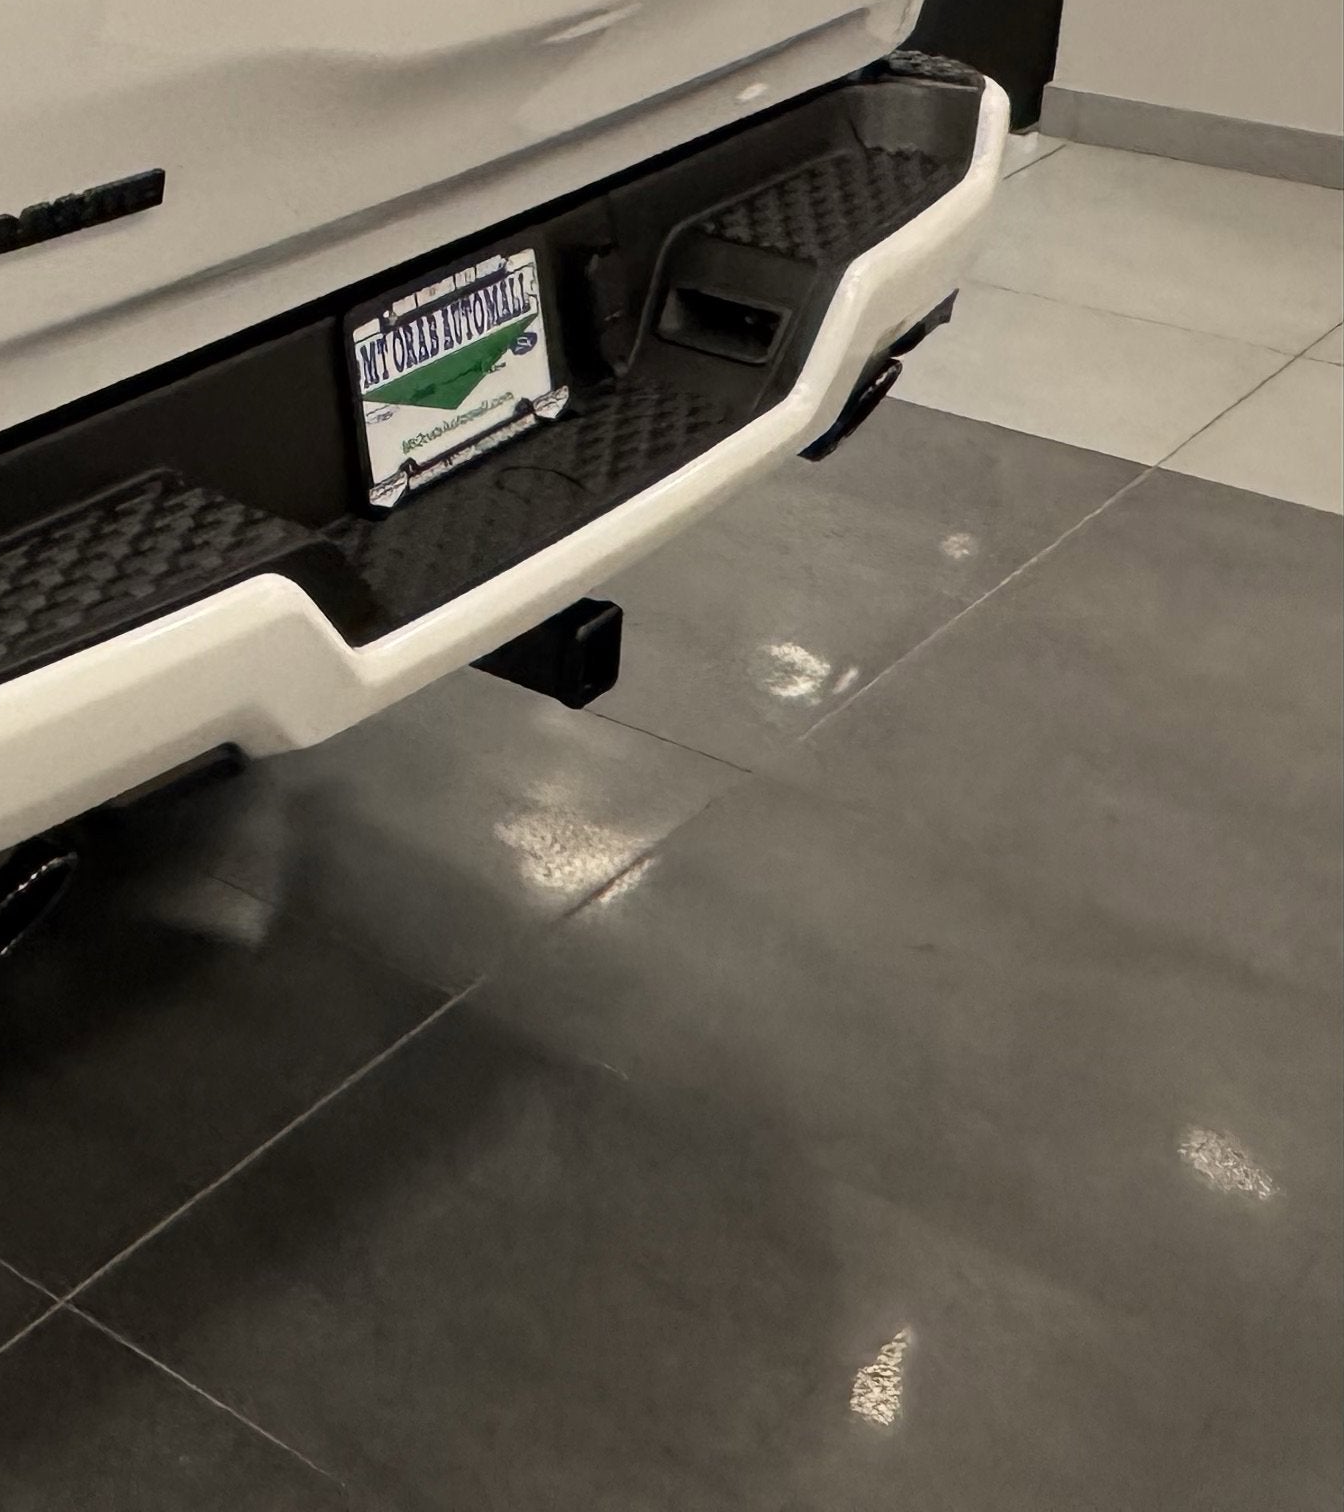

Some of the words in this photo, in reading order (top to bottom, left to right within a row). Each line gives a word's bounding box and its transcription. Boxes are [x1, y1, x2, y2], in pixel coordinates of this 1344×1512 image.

[359, 335, 390, 390] MT
[393, 312, 440, 372] ORAB
[442, 272, 531, 351] AUTOMALL
